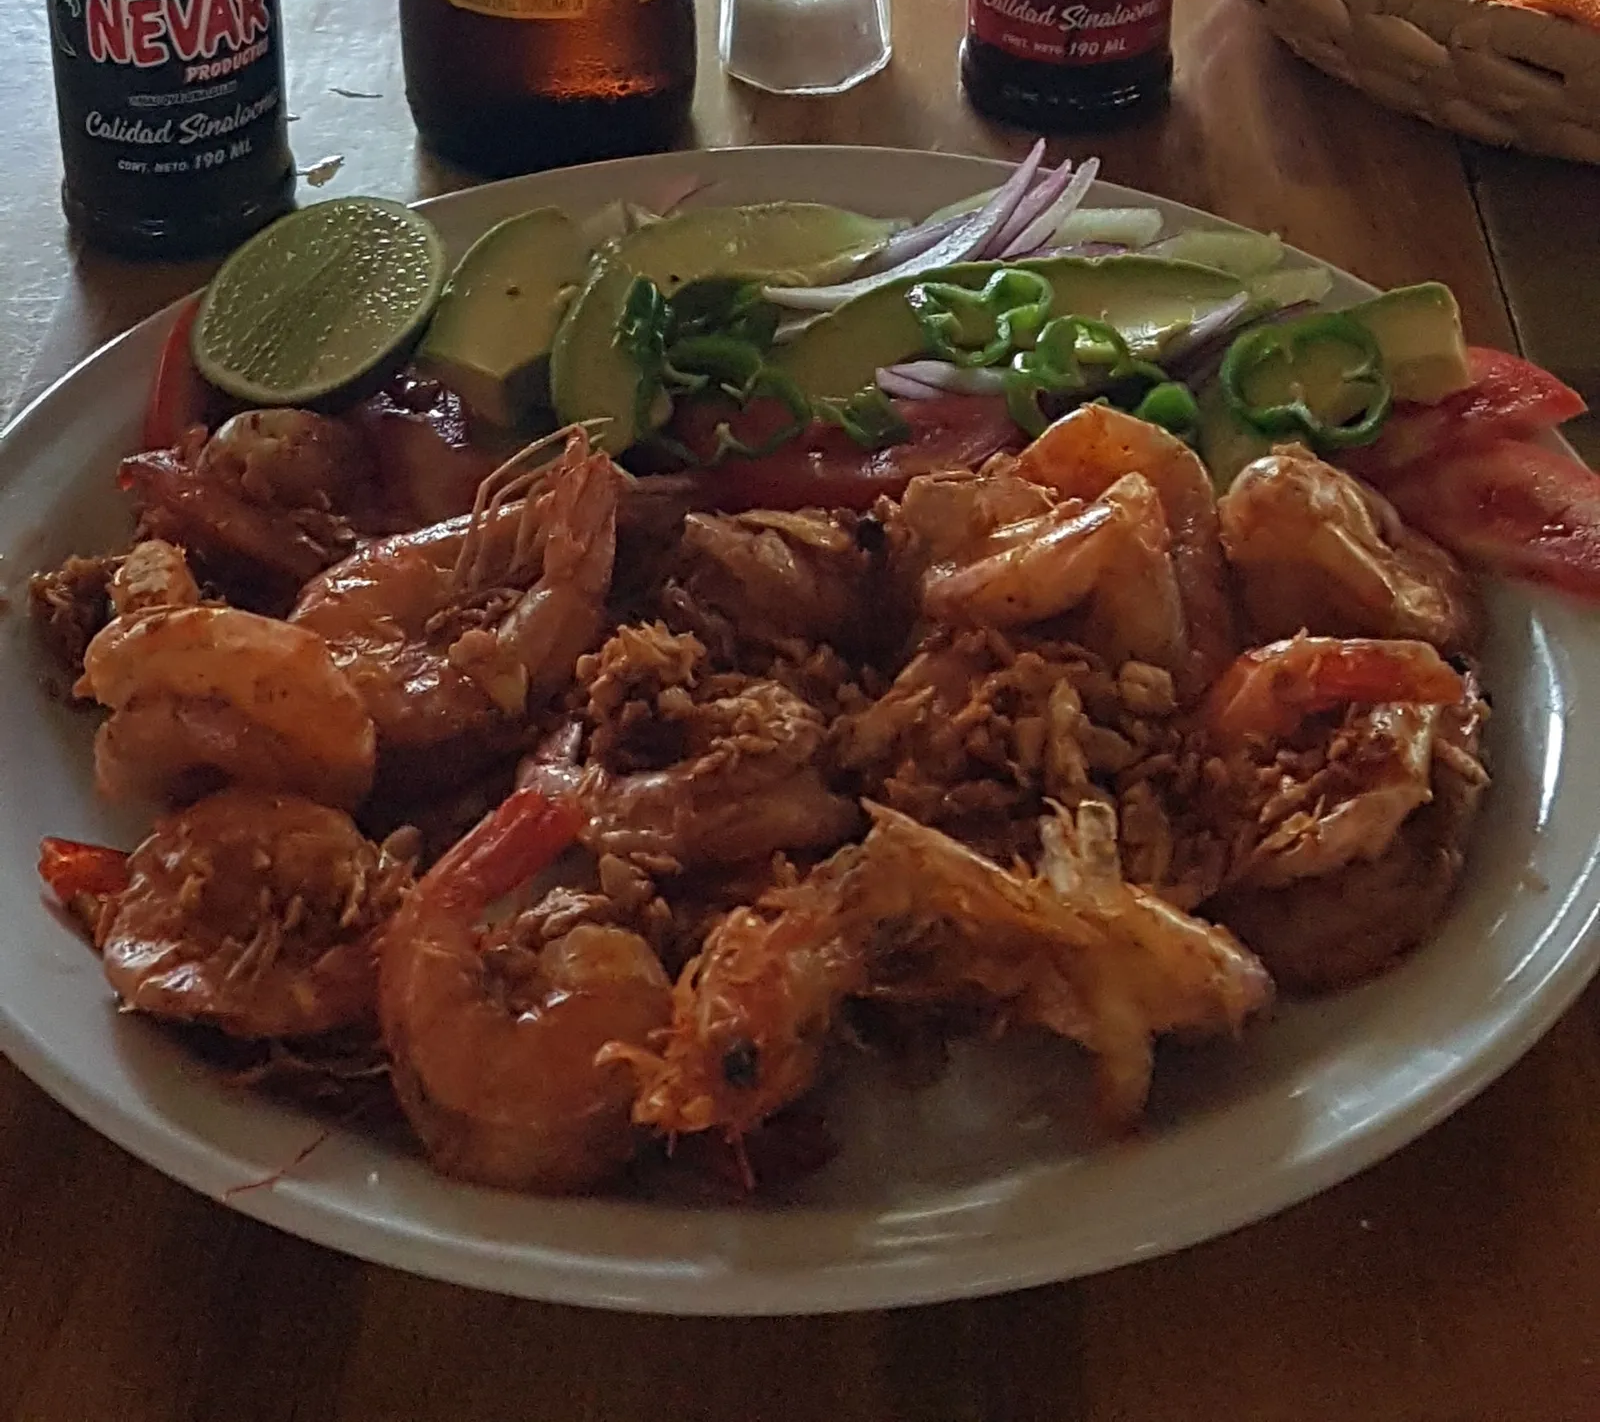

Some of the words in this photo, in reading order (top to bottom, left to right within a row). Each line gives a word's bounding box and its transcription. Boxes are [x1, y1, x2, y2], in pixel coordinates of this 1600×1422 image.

[1069, 41, 1099, 57] 190
[1103, 37, 1126, 55] ML
[86, 111, 174, 144] Calidad
[195, 149, 225, 169] 190
[230, 137, 252, 160] ML
